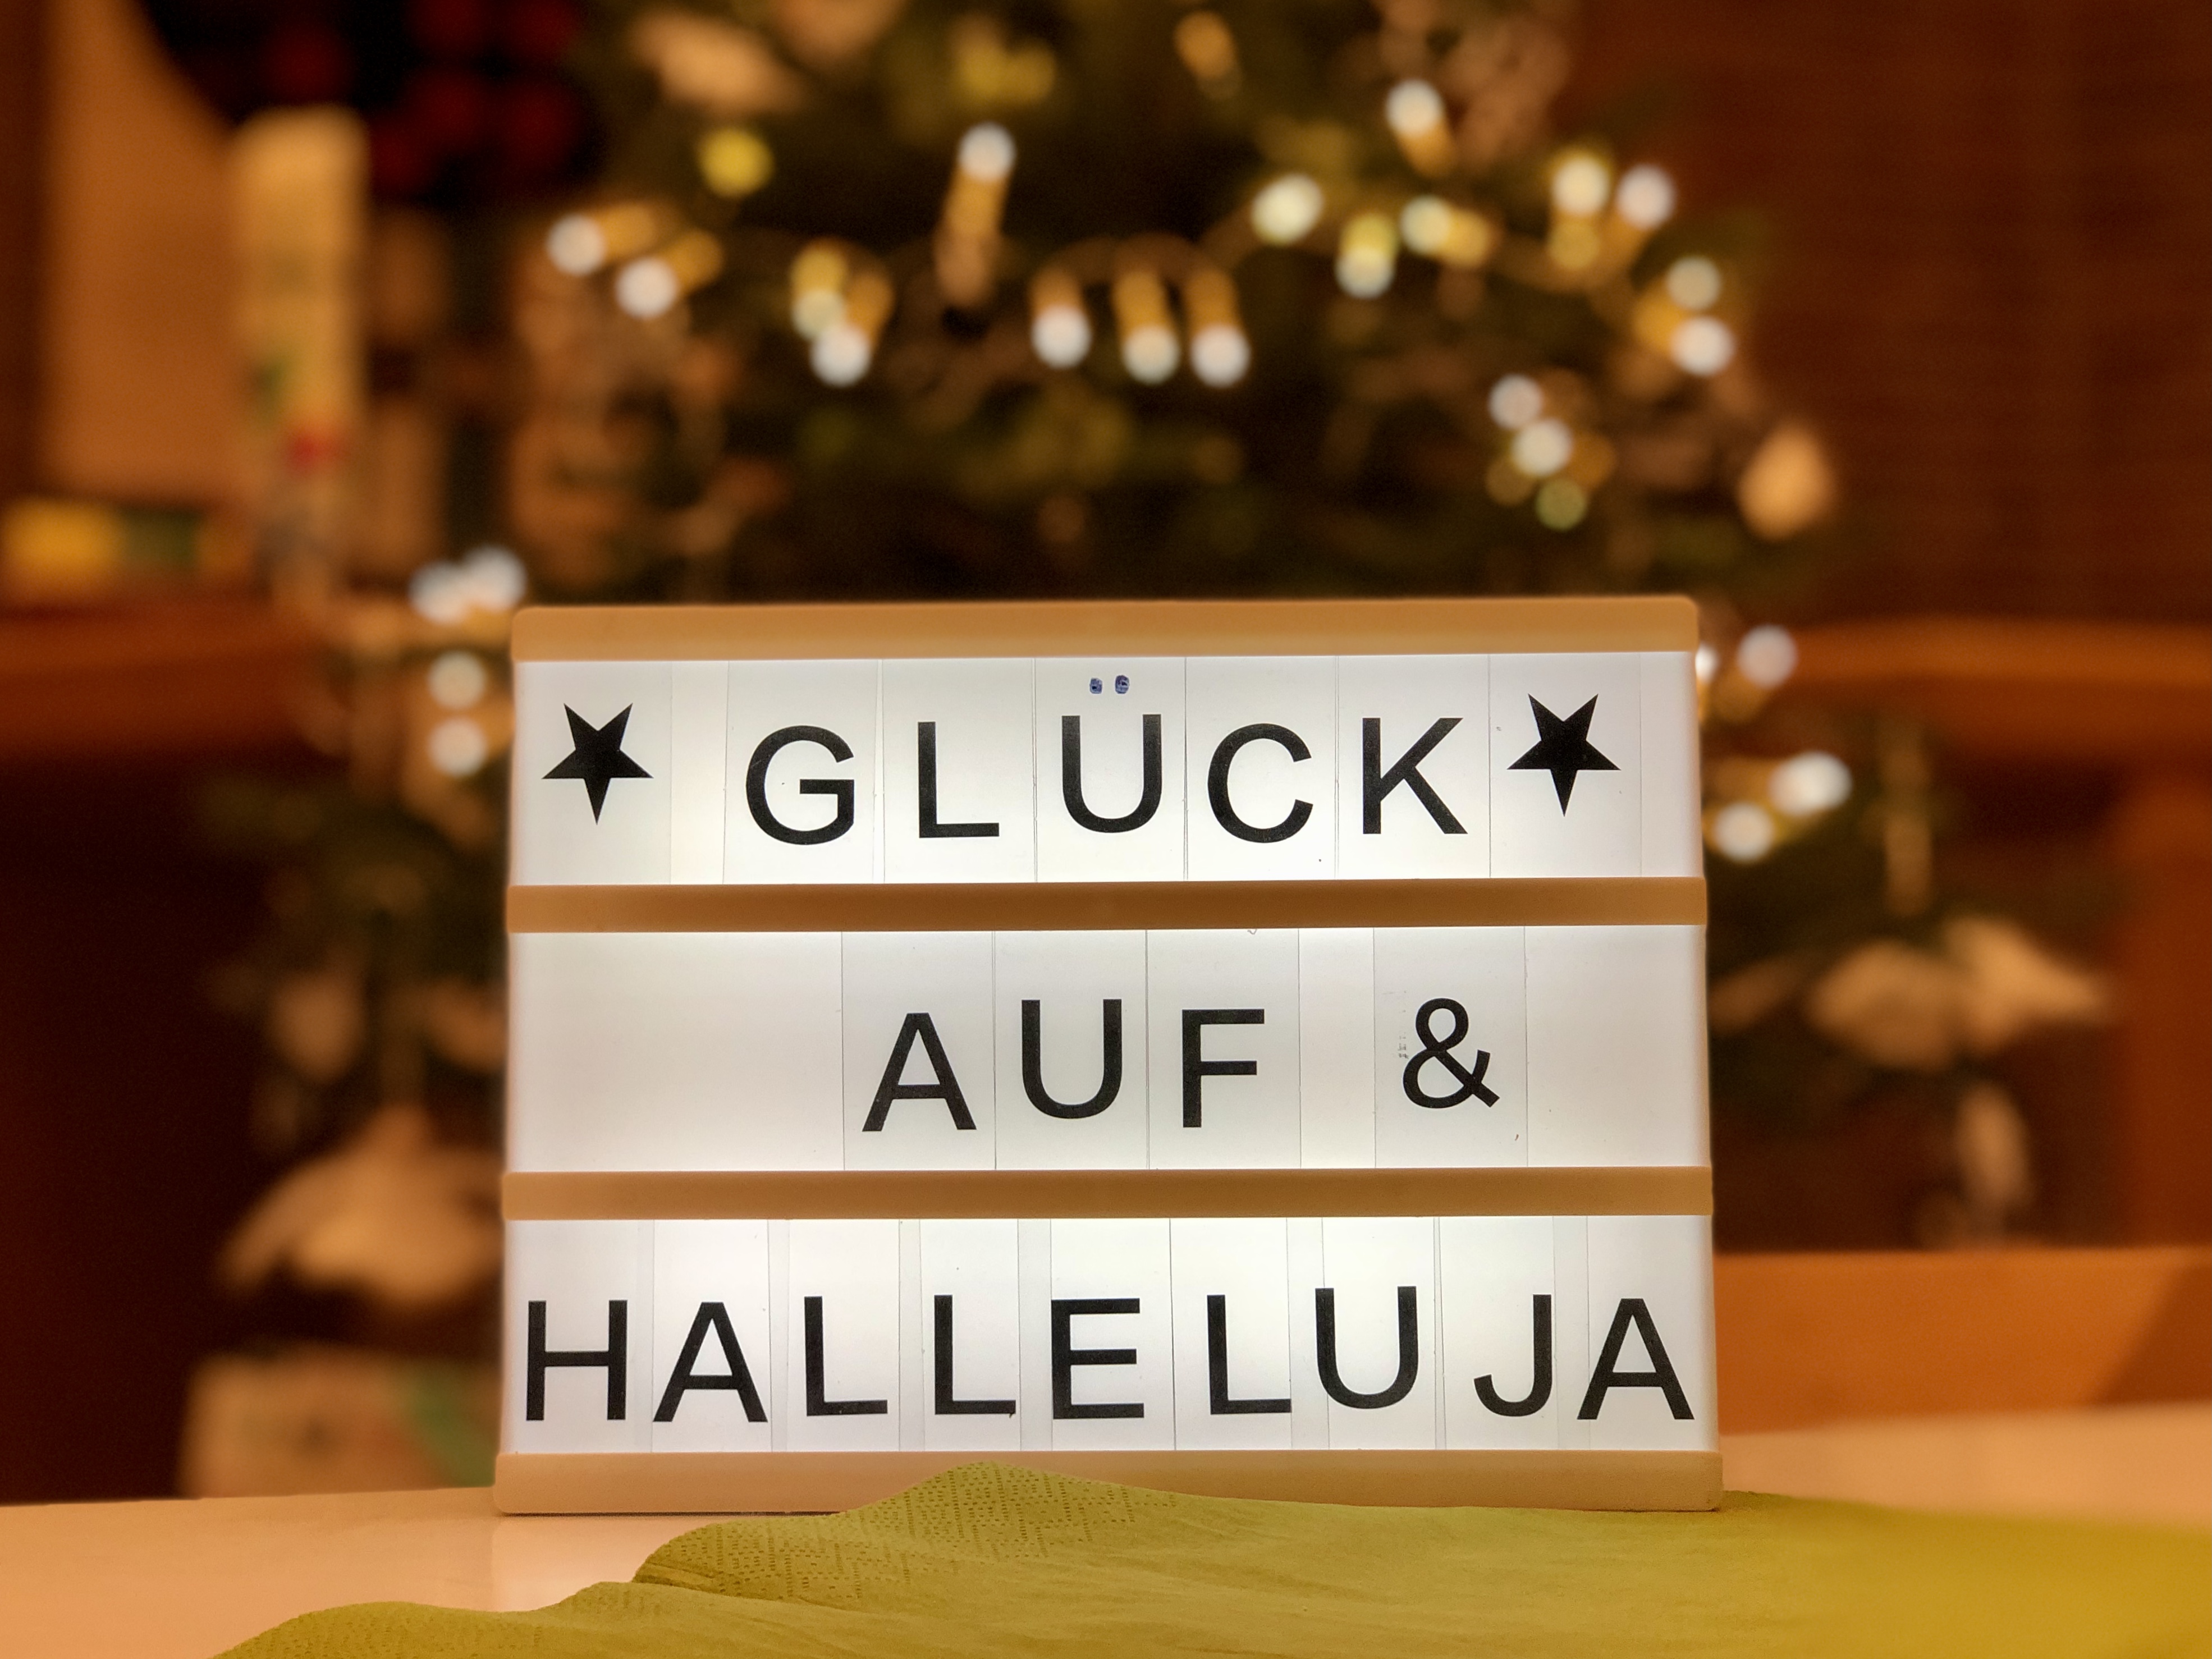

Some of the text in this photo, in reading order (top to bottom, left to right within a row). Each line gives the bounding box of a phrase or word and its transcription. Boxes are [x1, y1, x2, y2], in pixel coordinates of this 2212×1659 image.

[745, 674, 1468, 846] GLÜCK
[862, 997, 1500, 1133] AUF &
[525, 1286, 1695, 1423] HALLELUJA
